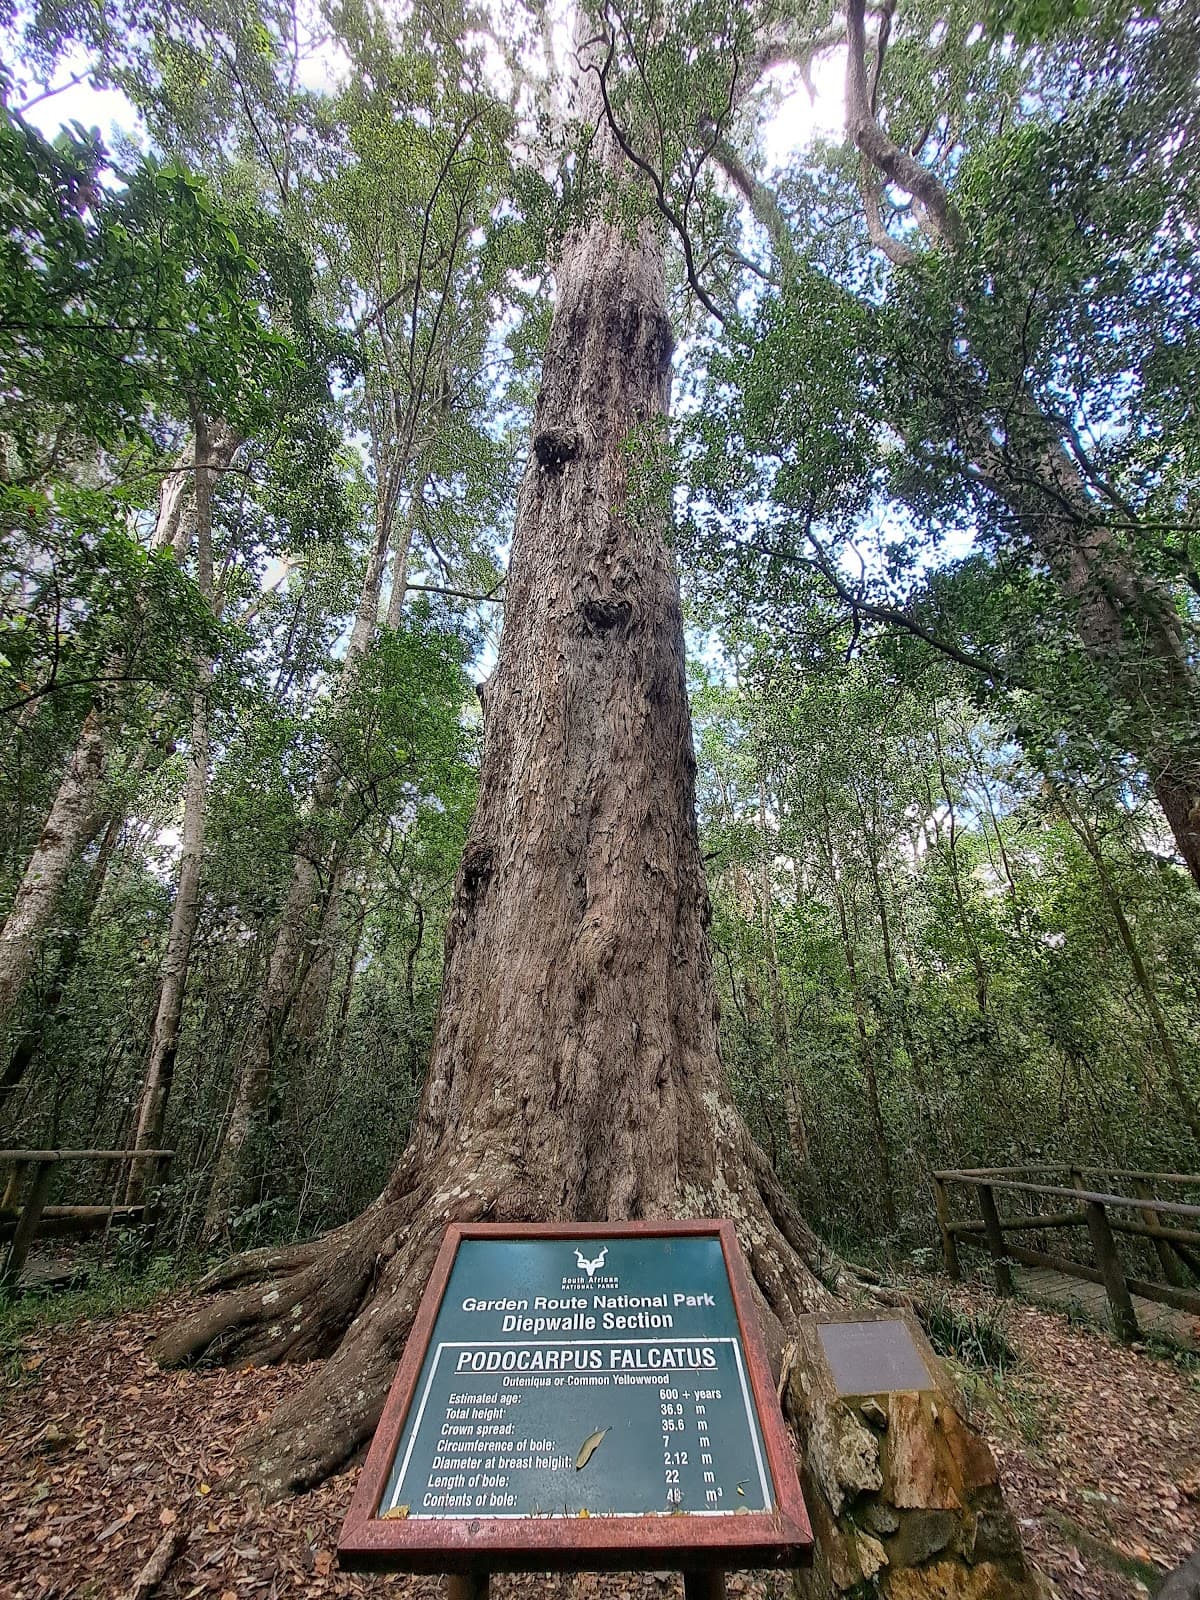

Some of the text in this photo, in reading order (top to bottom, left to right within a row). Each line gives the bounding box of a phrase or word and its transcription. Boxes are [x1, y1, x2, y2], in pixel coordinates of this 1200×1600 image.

[588, 1276, 619, 1284] African
[462, 1293, 716, 1312] Garden Route National Park
[502, 1311, 673, 1335] Diepwalle Section
[456, 1347, 716, 1371] PODOCARPUS FALCATUS
[502, 1376, 551, 1388] Outeniqua
[567, 1375, 610, 1386] Common
[612, 1374, 670, 1385] Yellowwood
[449, 1389, 722, 1406] Estimated age: 600 + years
[445, 1408, 469, 1419] Total
[660, 1404, 683, 1415] 36.9
[695, 1405, 706, 1414] m
[441, 1419, 708, 1437] Crown spread: 35.6 m
[437, 1435, 710, 1452] Circumference of bole: 7 m
[432, 1452, 713, 1471] Diameter at breast height: 2.12 m
[428, 1470, 715, 1489] Length of bole: 22 m
[423, 1493, 473, 1507] Contents
[476, 1493, 488, 1506] of
[489, 1493, 518, 1507] bole:
